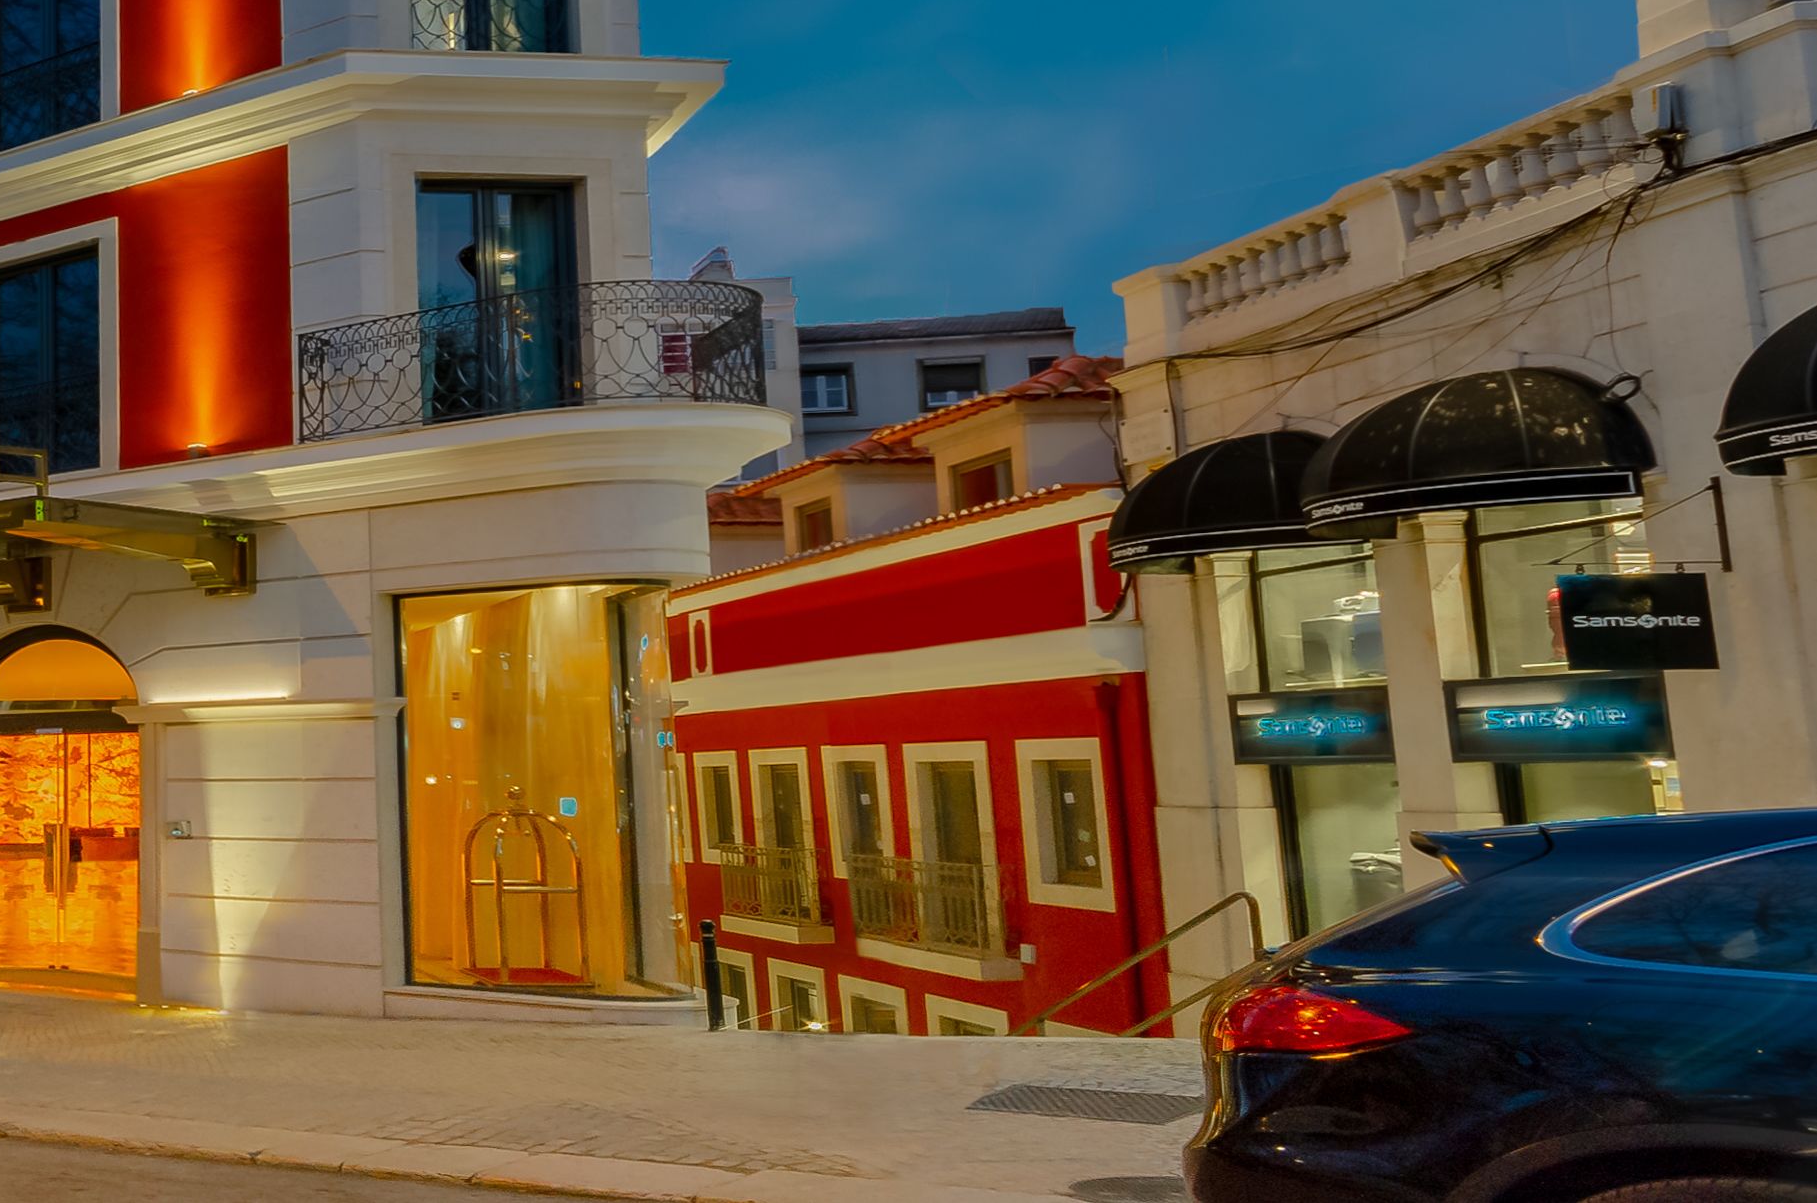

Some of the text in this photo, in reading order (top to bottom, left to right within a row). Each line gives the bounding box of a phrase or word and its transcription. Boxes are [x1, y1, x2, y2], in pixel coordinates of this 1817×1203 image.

[1572, 613, 1701, 628] Samsonite
[1257, 716, 1364, 737] Samsonite
[1482, 706, 1627, 729] Samsonite
